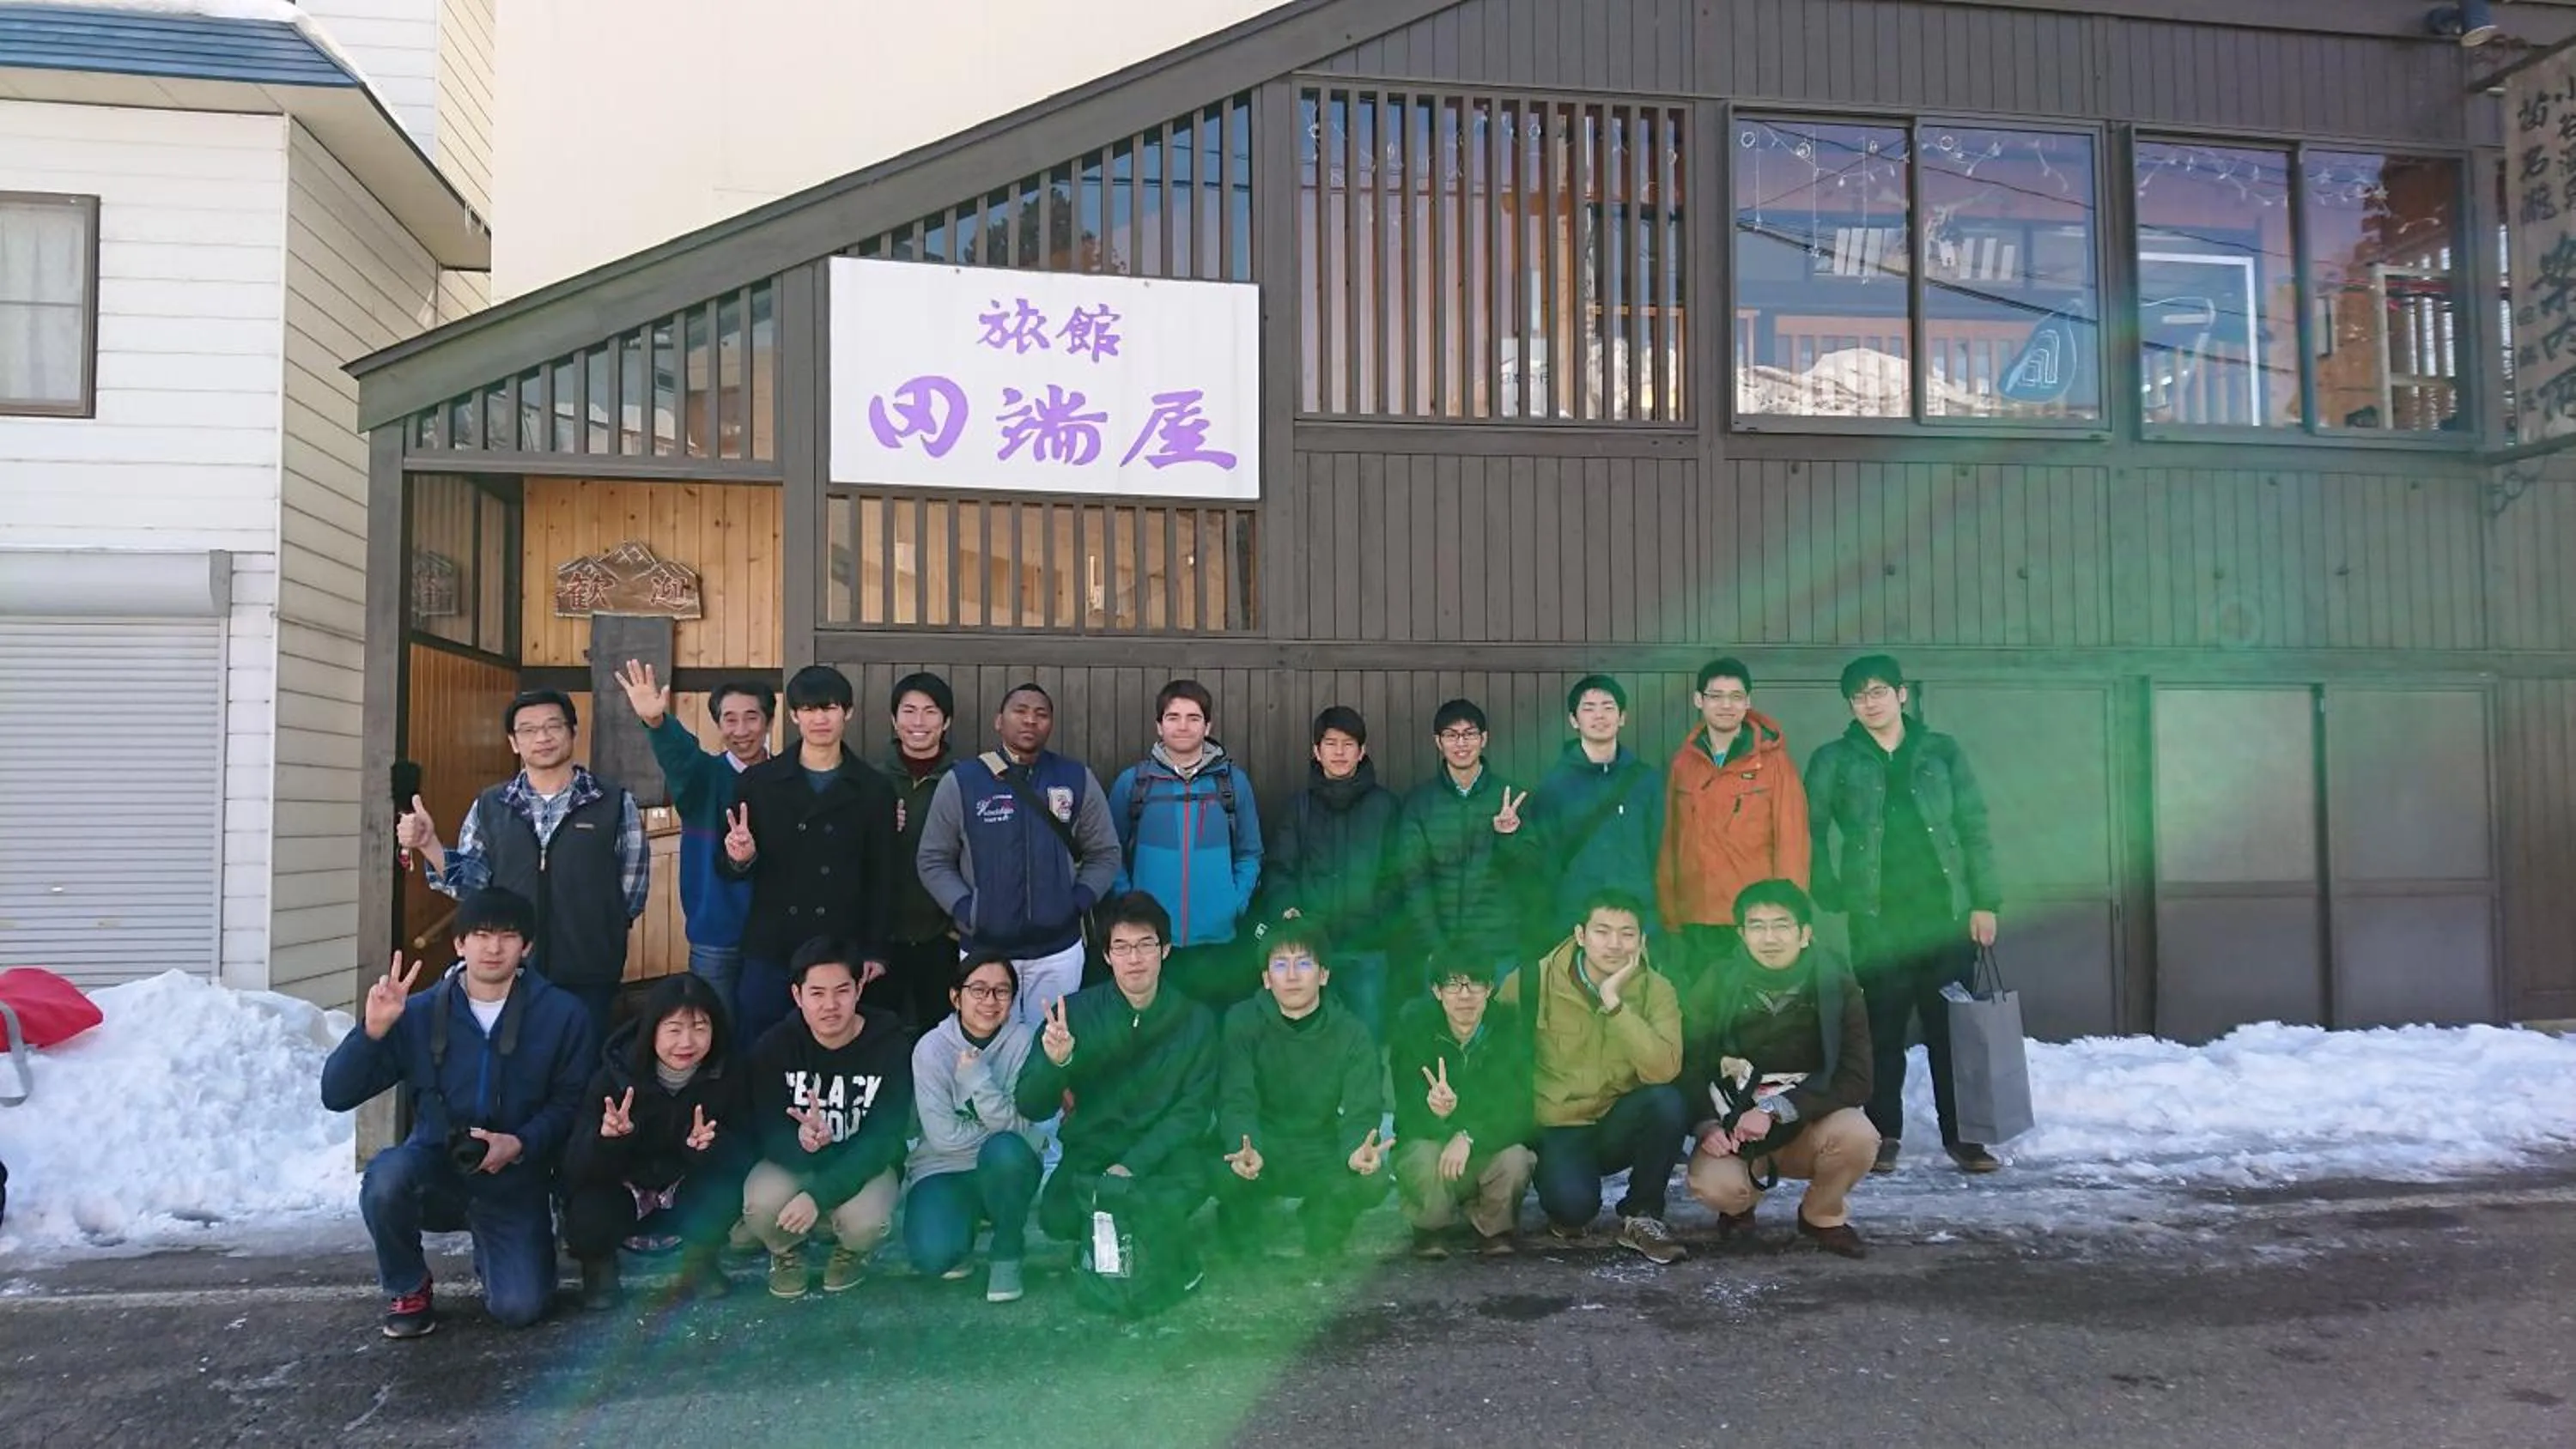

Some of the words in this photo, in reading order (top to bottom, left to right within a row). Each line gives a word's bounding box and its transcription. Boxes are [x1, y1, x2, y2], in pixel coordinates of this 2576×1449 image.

[976, 298, 1121, 363] 旅館
[868, 375, 1237, 470] 田端屋
[556, 571, 694, 611] 歓迎
